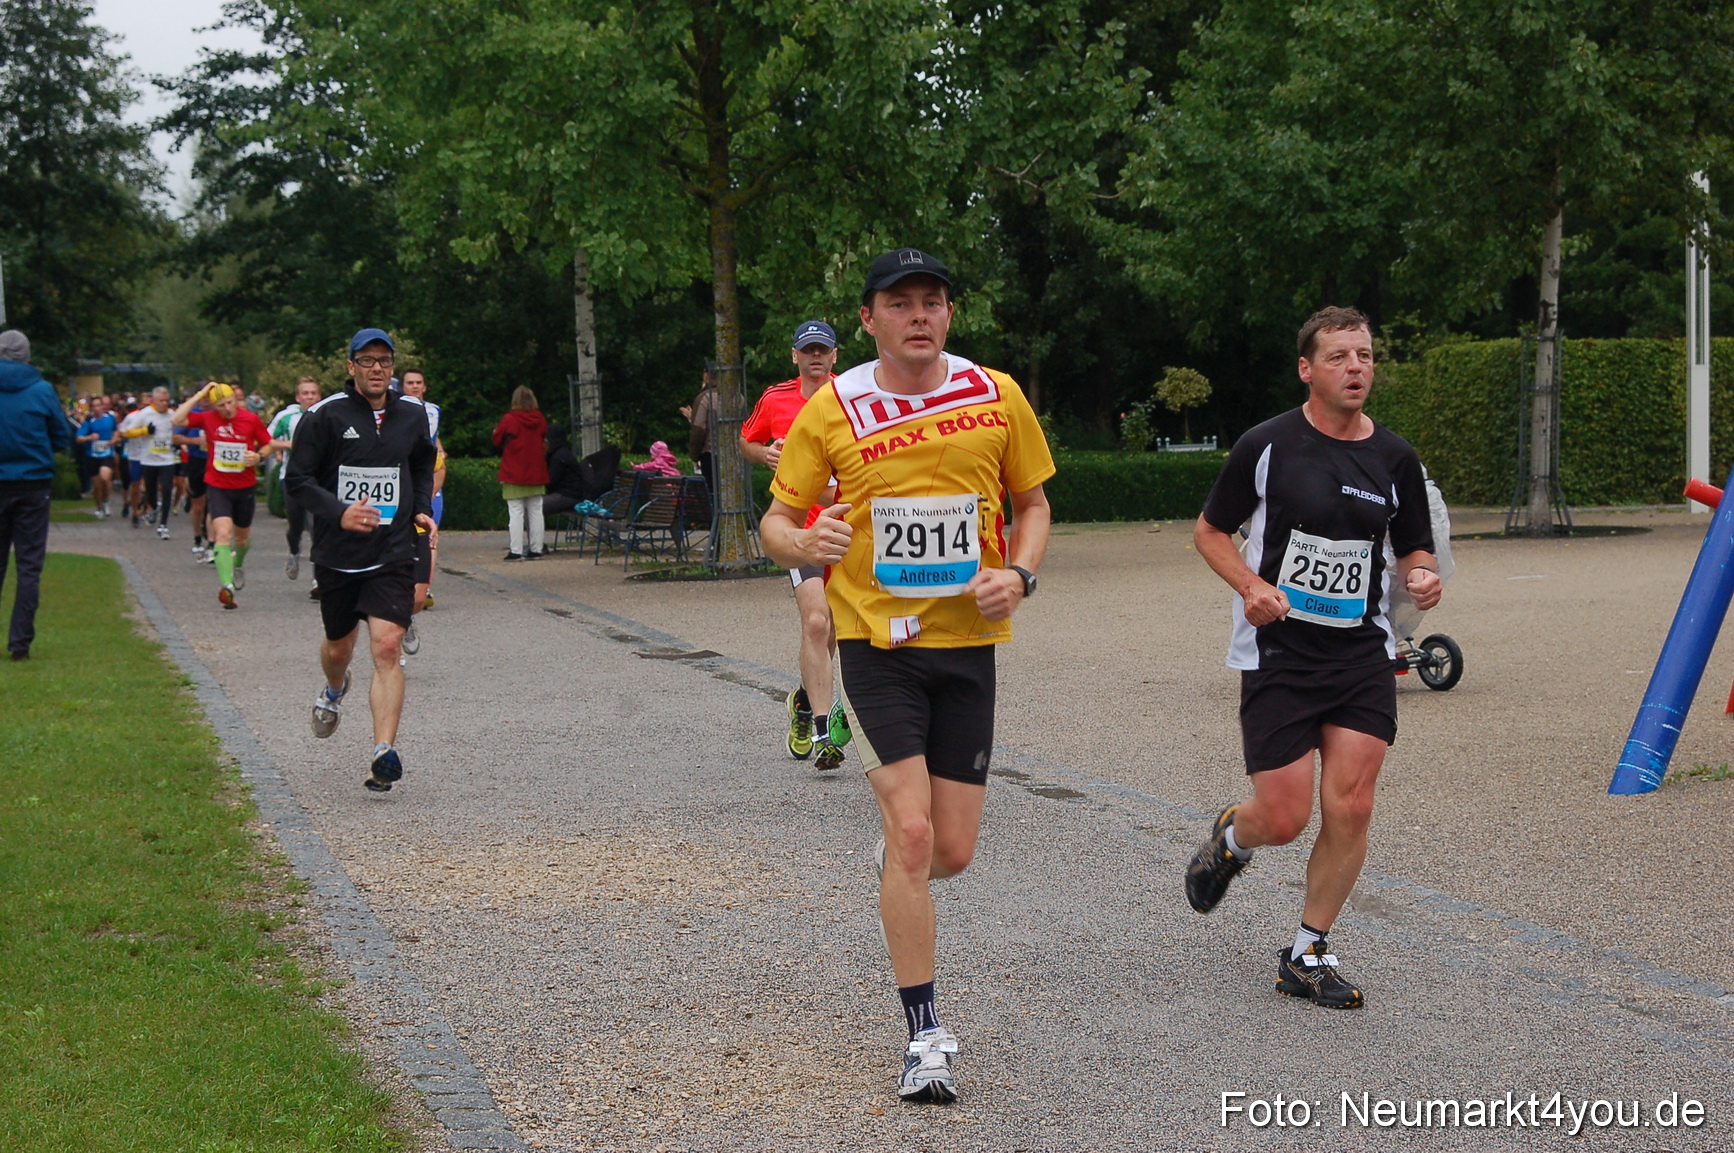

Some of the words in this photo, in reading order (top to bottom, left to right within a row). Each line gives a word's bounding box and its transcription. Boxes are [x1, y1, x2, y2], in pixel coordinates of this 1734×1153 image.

[860, 427, 930, 465] MAX
[936, 411, 1009, 437] BÖGL
[221, 450, 240, 461] 432
[340, 471, 361, 479] PARTL
[344, 480, 394, 502] 2849
[873, 507, 909, 517] PARTL
[912, 506, 961, 517] Neumarkt
[884, 520, 970, 559] 2914
[1290, 538, 1319, 555] PARTL
[1321, 547, 1358, 558] Neumarkt
[900, 568, 957, 583] Andreas
[1289, 555, 1362, 594] 2528
[1305, 597, 1340, 615] Claus
